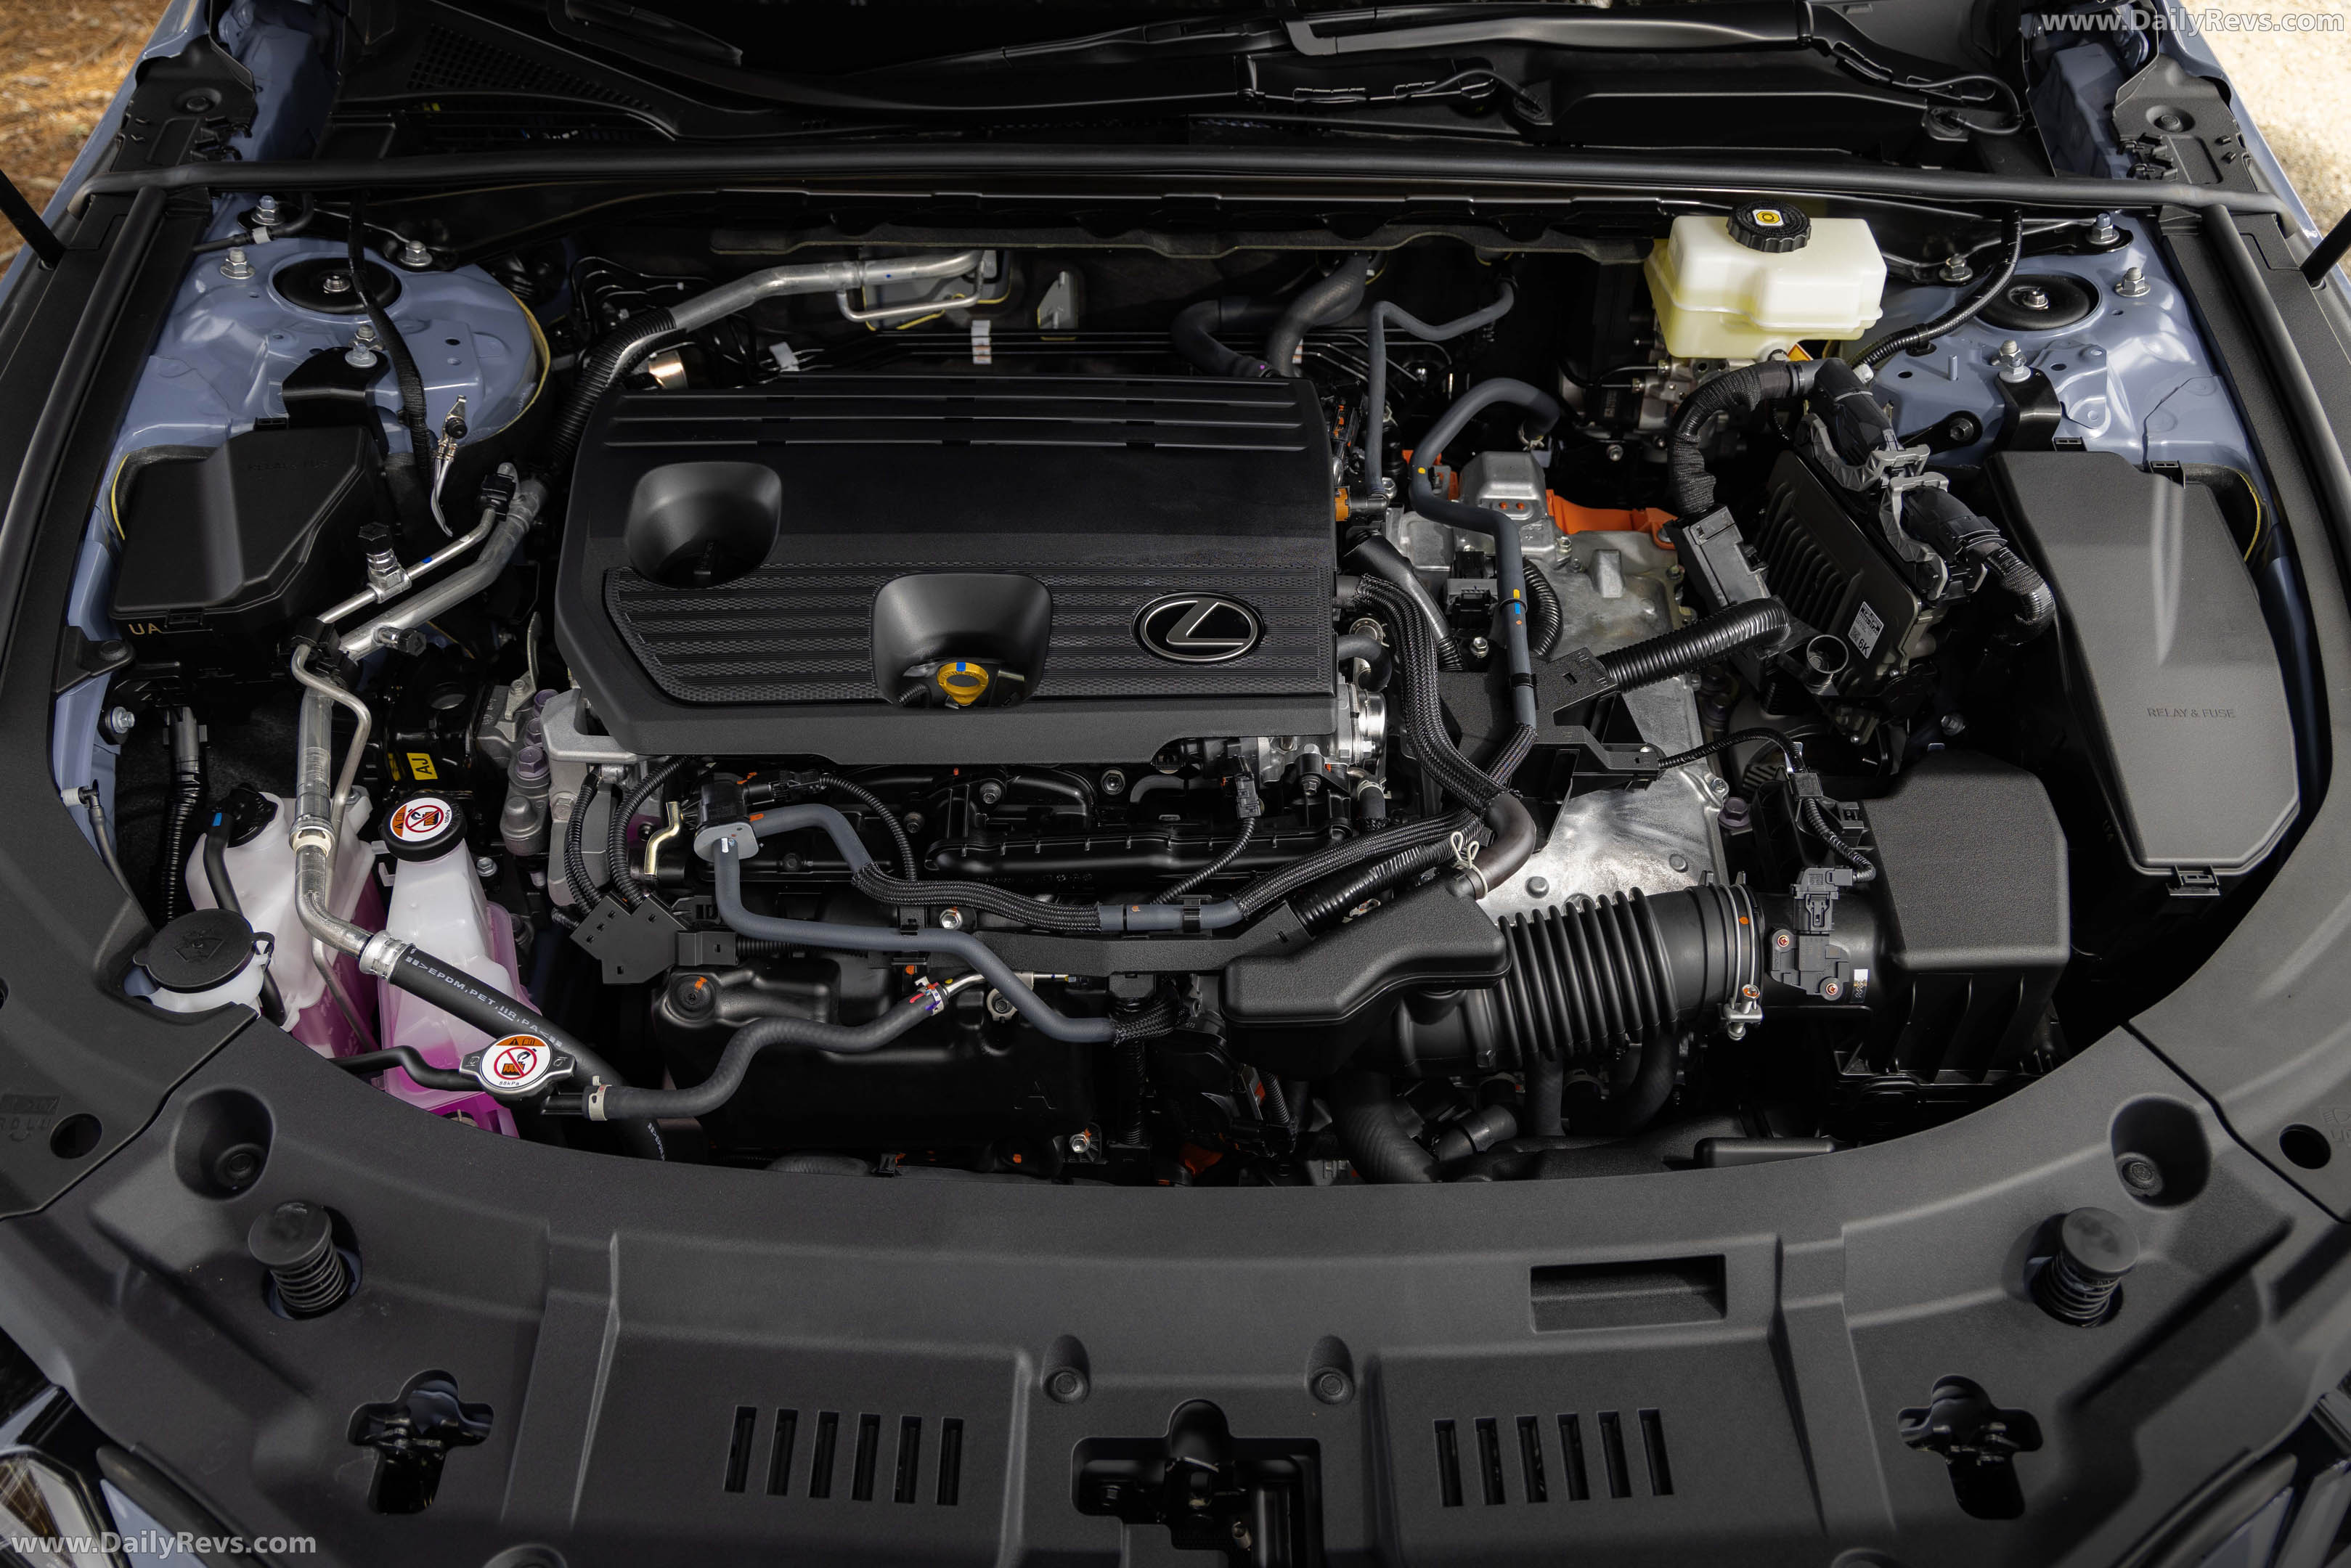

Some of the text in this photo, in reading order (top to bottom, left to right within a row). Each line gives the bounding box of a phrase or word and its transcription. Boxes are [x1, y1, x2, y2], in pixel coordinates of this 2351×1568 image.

[129, 622, 161, 635] UA
[1858, 638, 1870, 656] 6K
[2147, 707, 2189, 719] RELAY
[2202, 708, 2236, 719] FUSE
[412, 758, 433, 775] AJ
